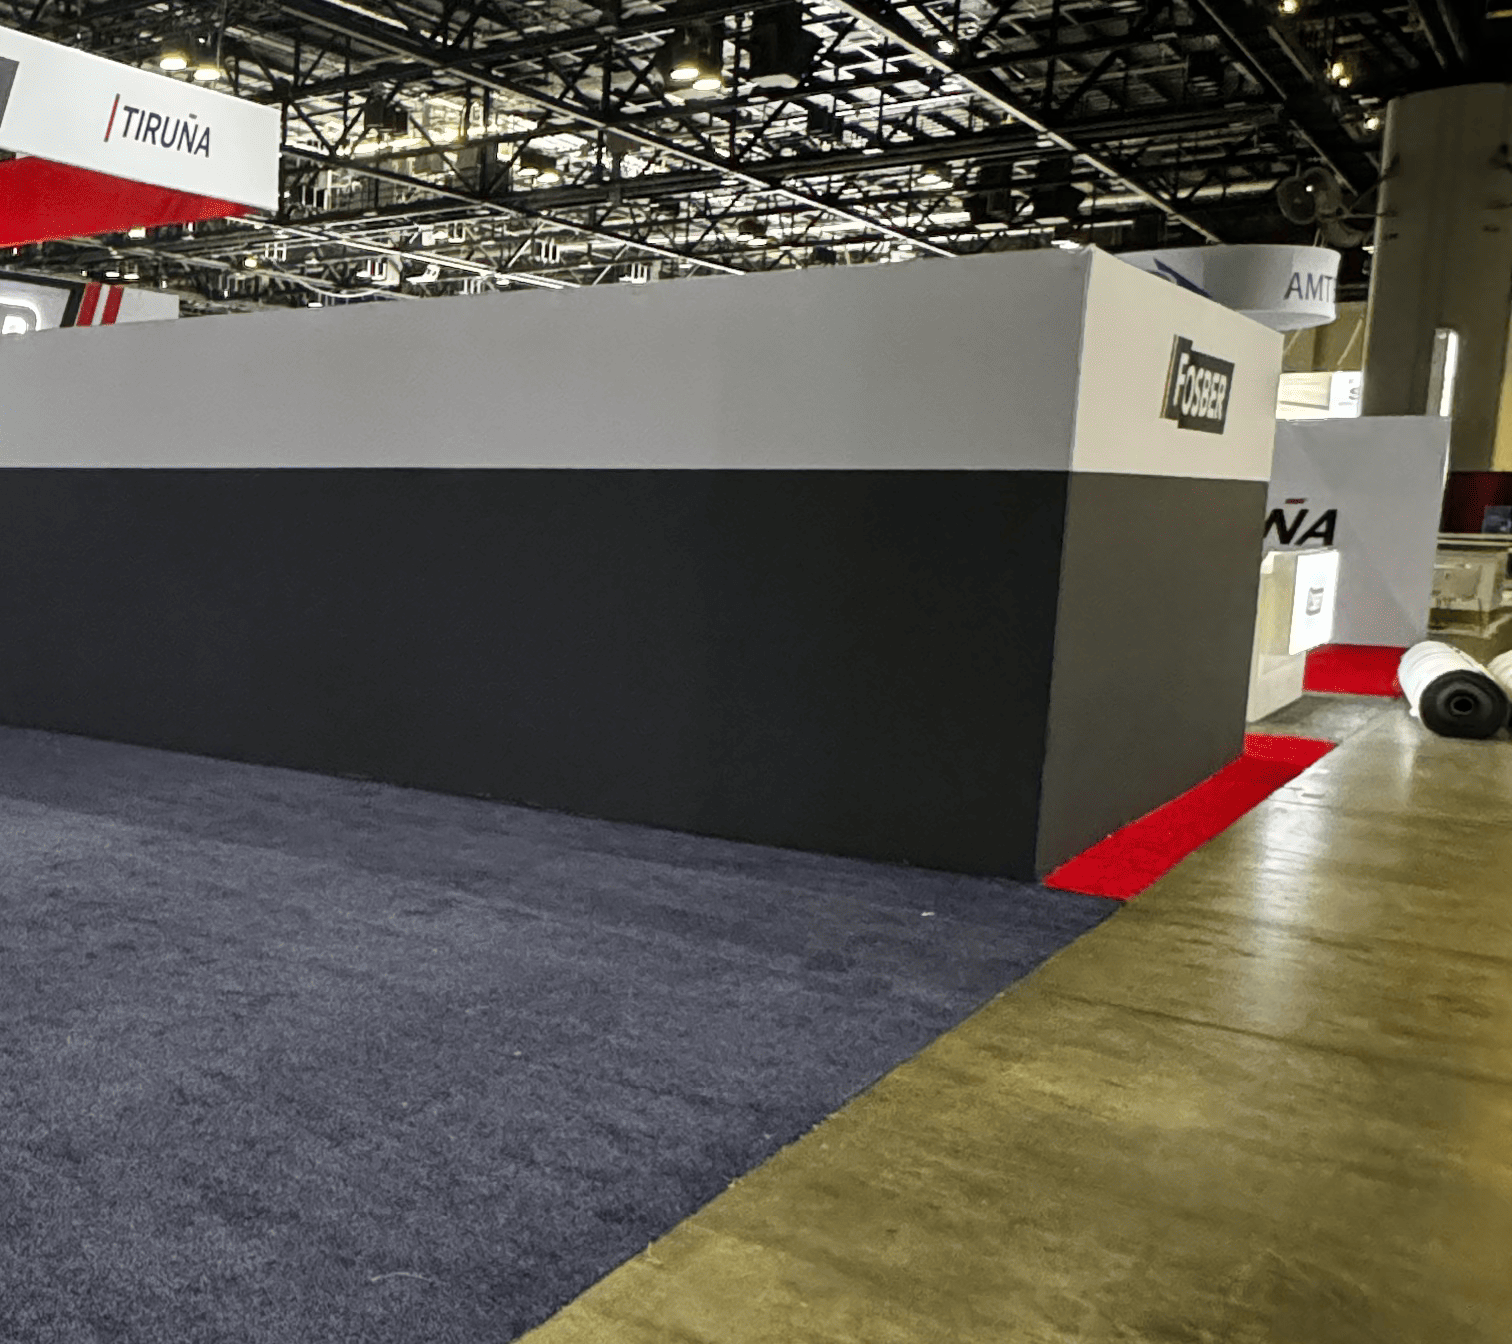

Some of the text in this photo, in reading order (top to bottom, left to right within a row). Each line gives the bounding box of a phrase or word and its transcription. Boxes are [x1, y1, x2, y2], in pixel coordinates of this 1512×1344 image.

[123, 105, 211, 157] TIRUÑA
[1284, 272, 1337, 303] AMT
[1173, 353, 1228, 421] FOSBER
[1263, 498, 1338, 546] ÑA
